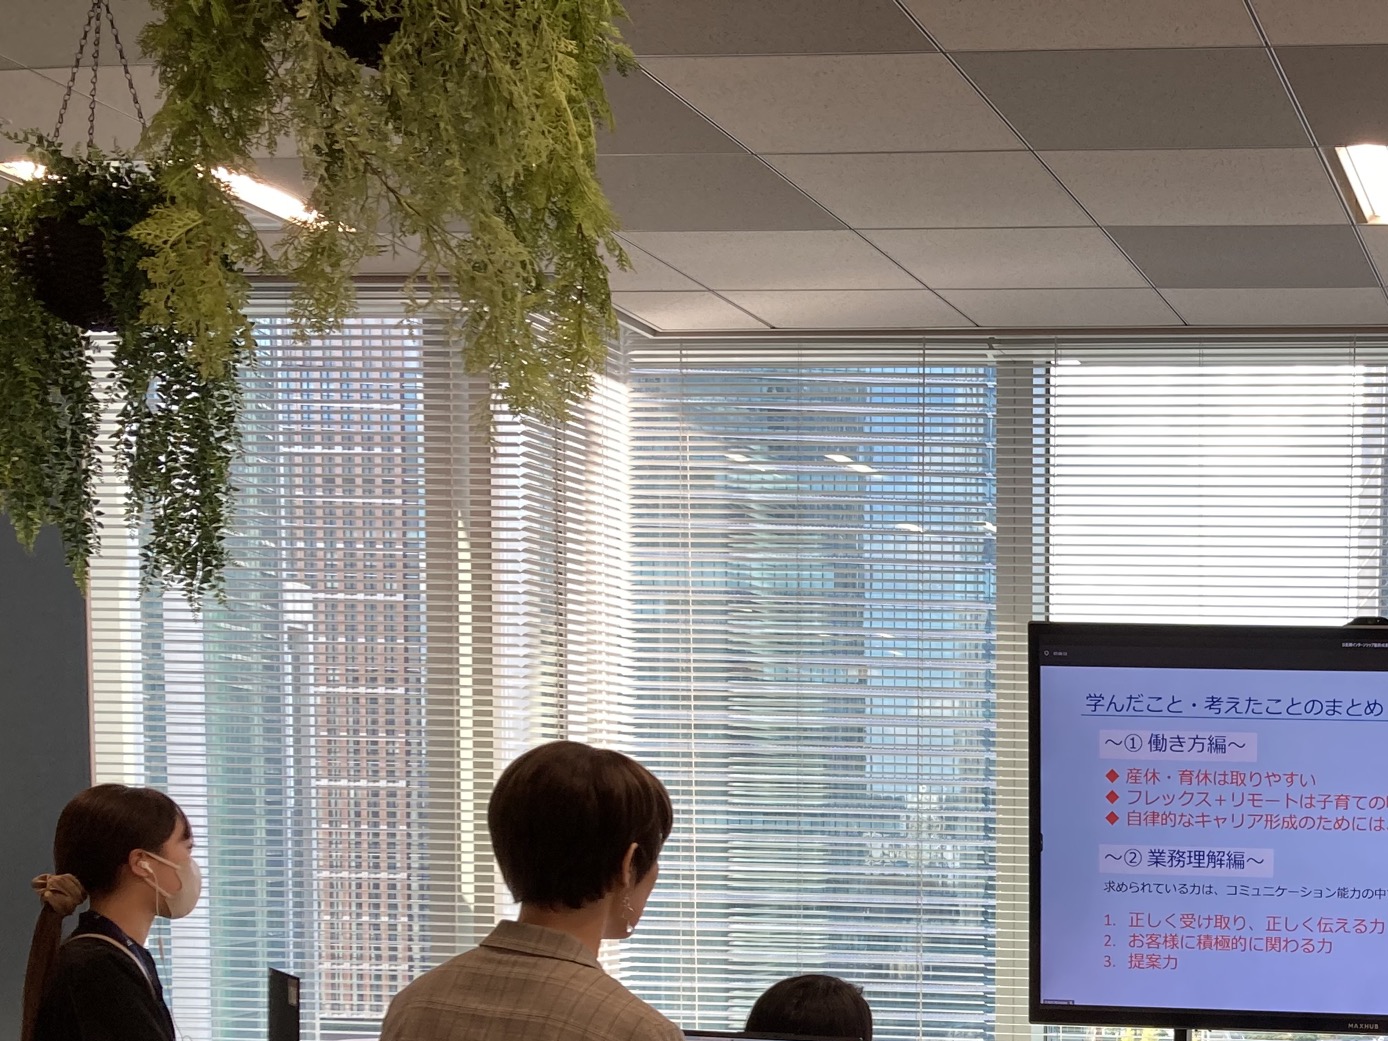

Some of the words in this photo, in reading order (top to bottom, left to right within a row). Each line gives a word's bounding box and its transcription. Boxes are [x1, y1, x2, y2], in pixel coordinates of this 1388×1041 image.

[1085, 693, 1384, 717] 学んだこと・考えたことのまとめ
[1125, 768, 1316, 788] 産休・育休は取りやすい
[1128, 911, 1385, 935] 正しく受け取り、正しく伝える力
[1128, 933, 1333, 954] お客様に積極的に関わる力
[1128, 953, 1178, 970] 提案力
